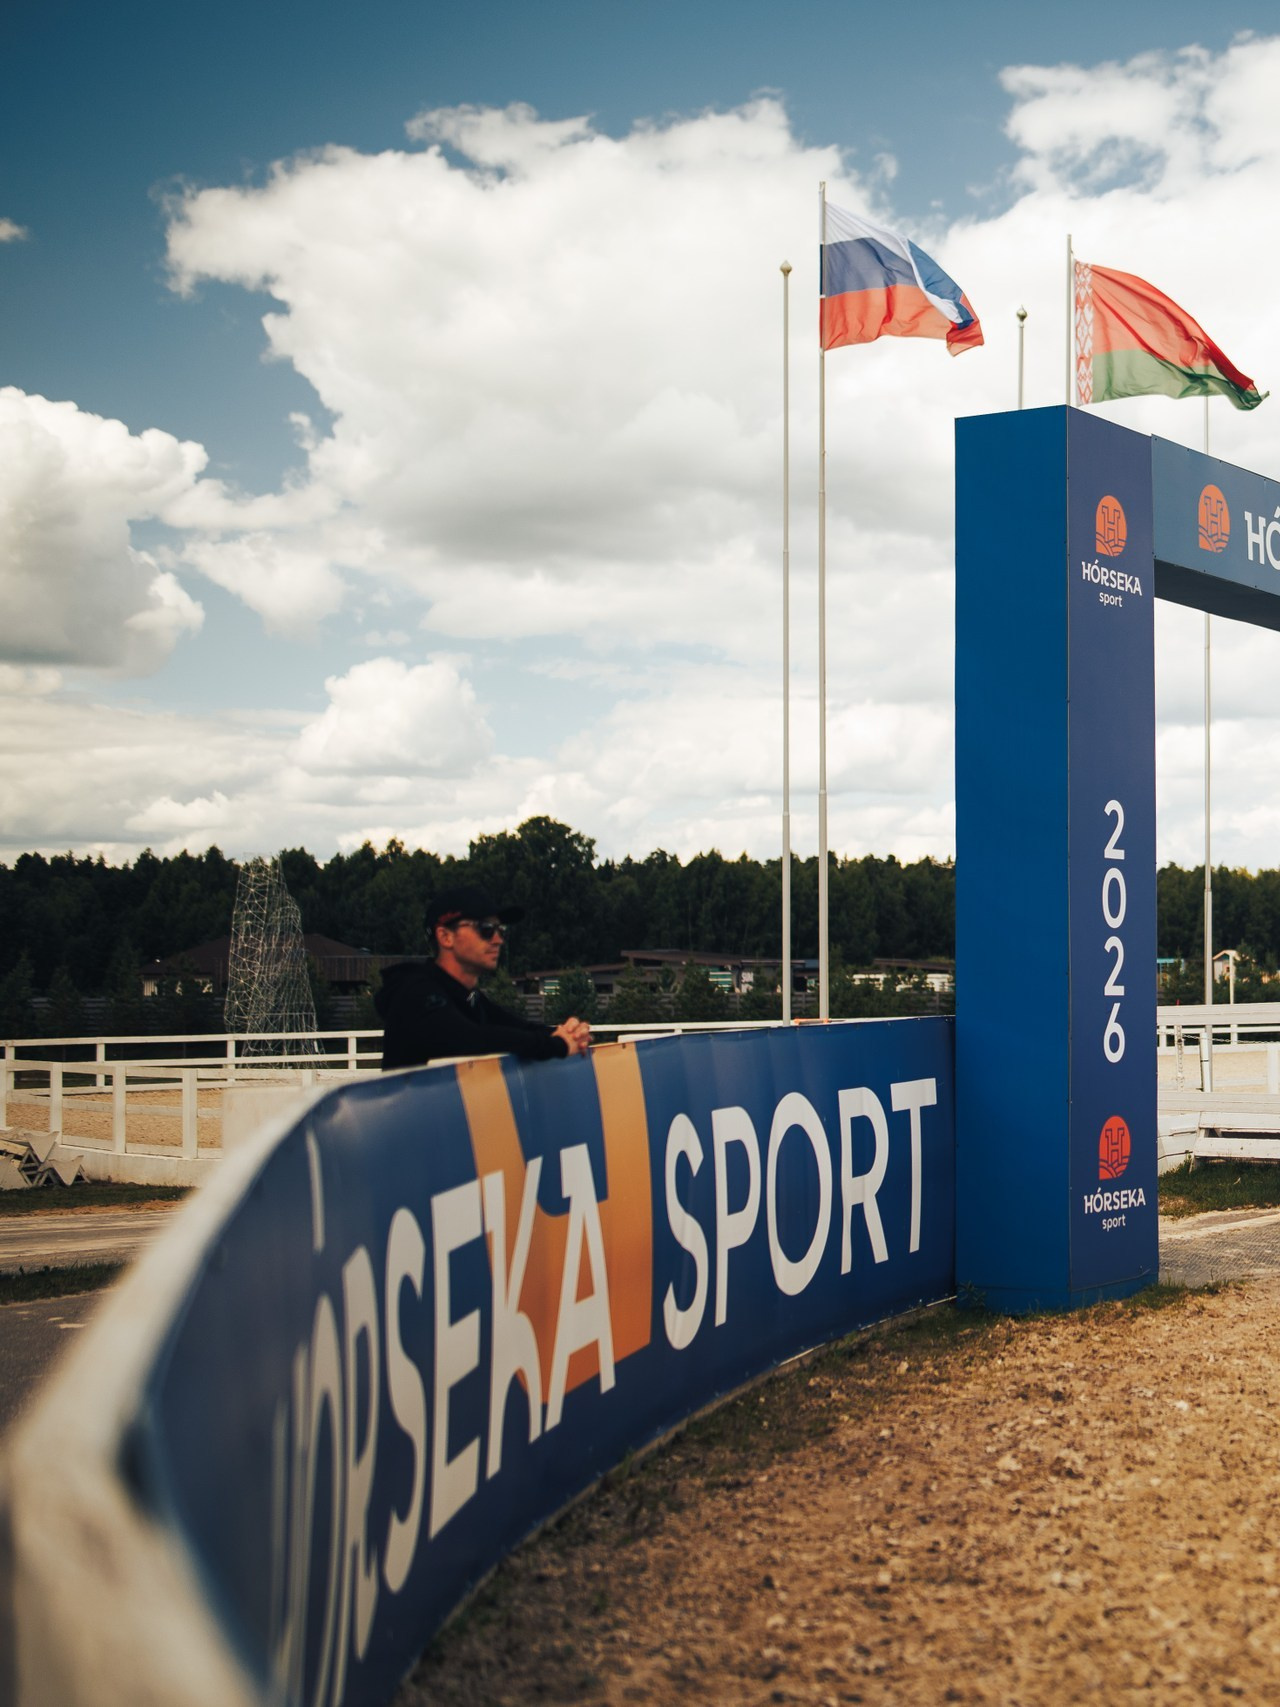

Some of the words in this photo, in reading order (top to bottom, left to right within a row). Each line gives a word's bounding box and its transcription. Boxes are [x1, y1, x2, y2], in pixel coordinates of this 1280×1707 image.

[1081, 559, 1142, 596] HÓRSEKA
[1099, 592, 1123, 607] sport
[1101, 799, 1127, 1063] 2026
[663, 1077, 938, 1351] SPORT
[1084, 1187, 1146, 1214] HÓRSEKA
[1102, 1214, 1126, 1232] sport
